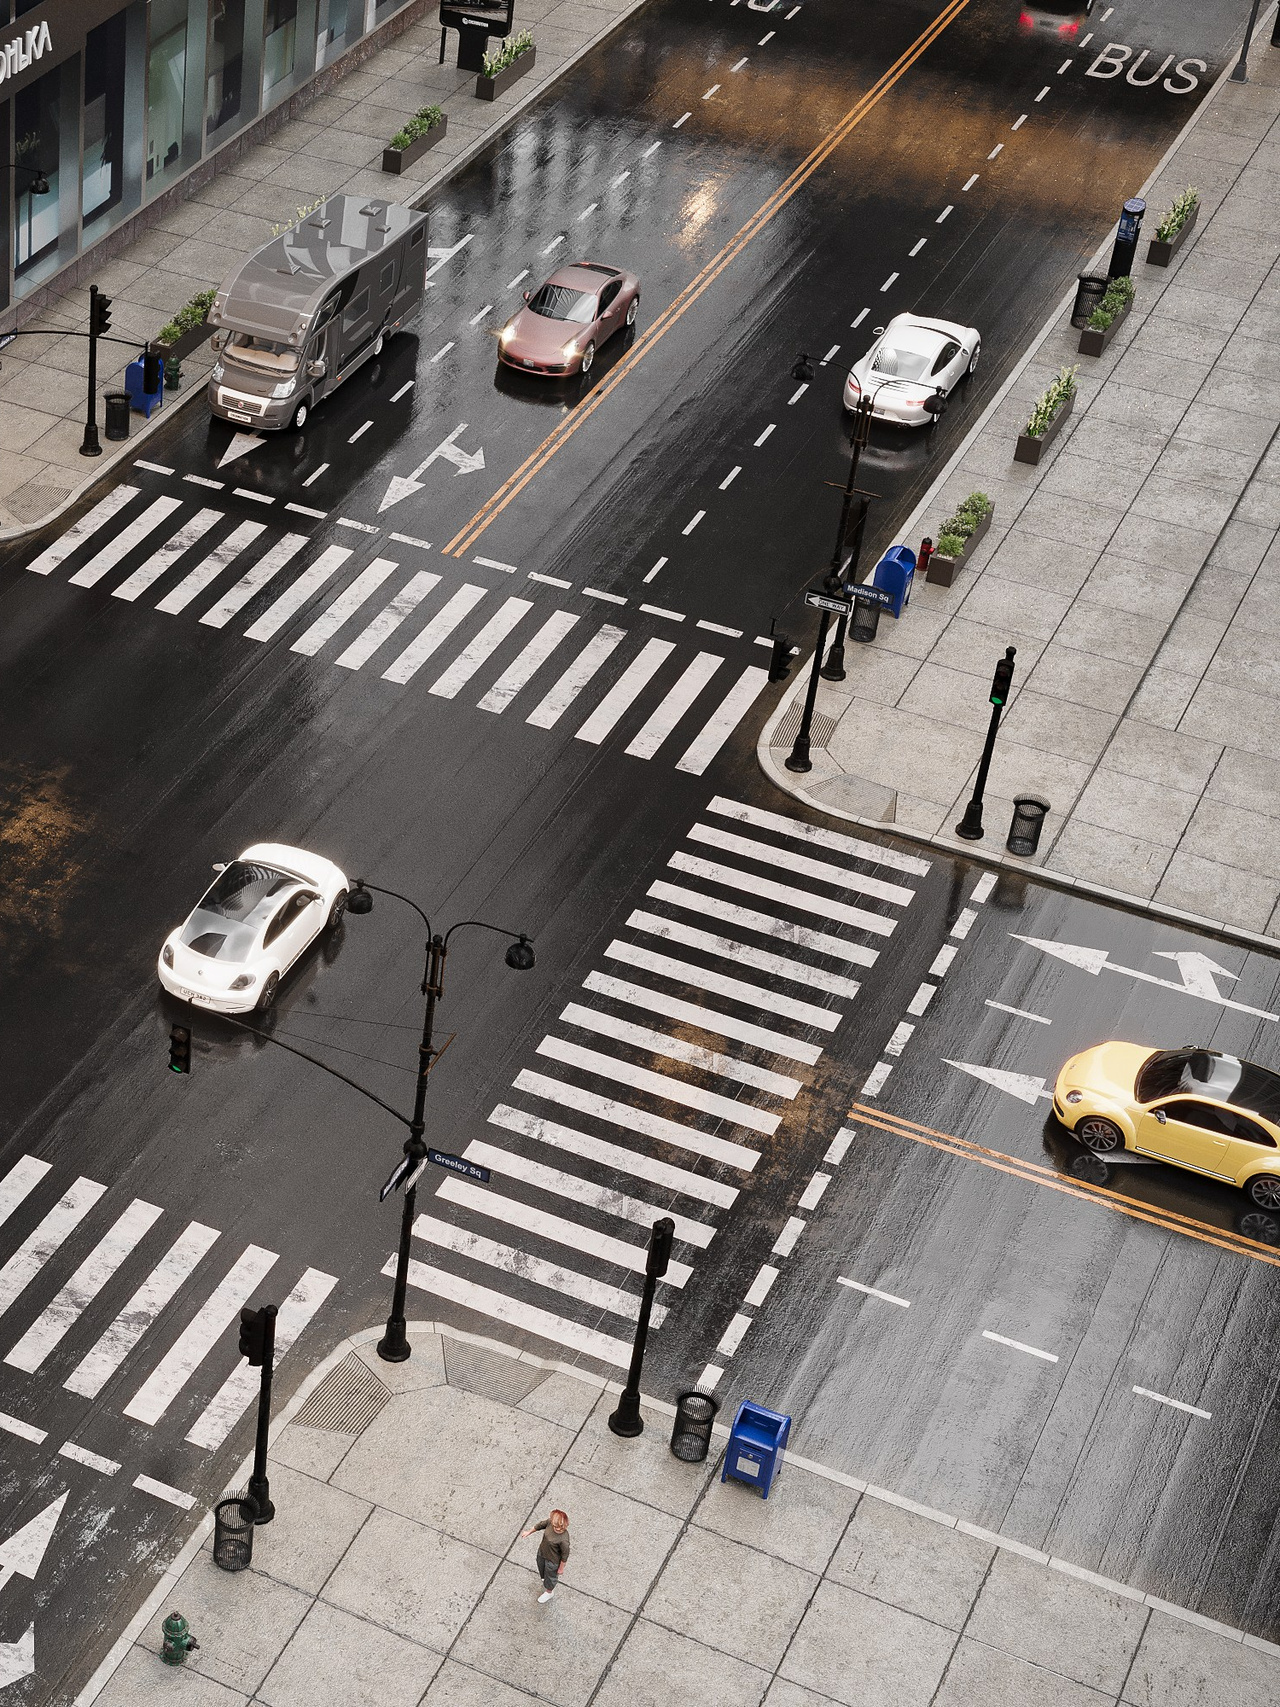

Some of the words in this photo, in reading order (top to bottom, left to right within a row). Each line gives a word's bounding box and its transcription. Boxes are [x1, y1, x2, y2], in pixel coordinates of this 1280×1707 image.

[1084, 42, 1208, 94] BUS
[847, 584, 878, 599] Madison
[878, 593, 890, 603] Sq
[434, 1154, 468, 1173] Greeley
[469, 1166, 482, 1179] Sq
